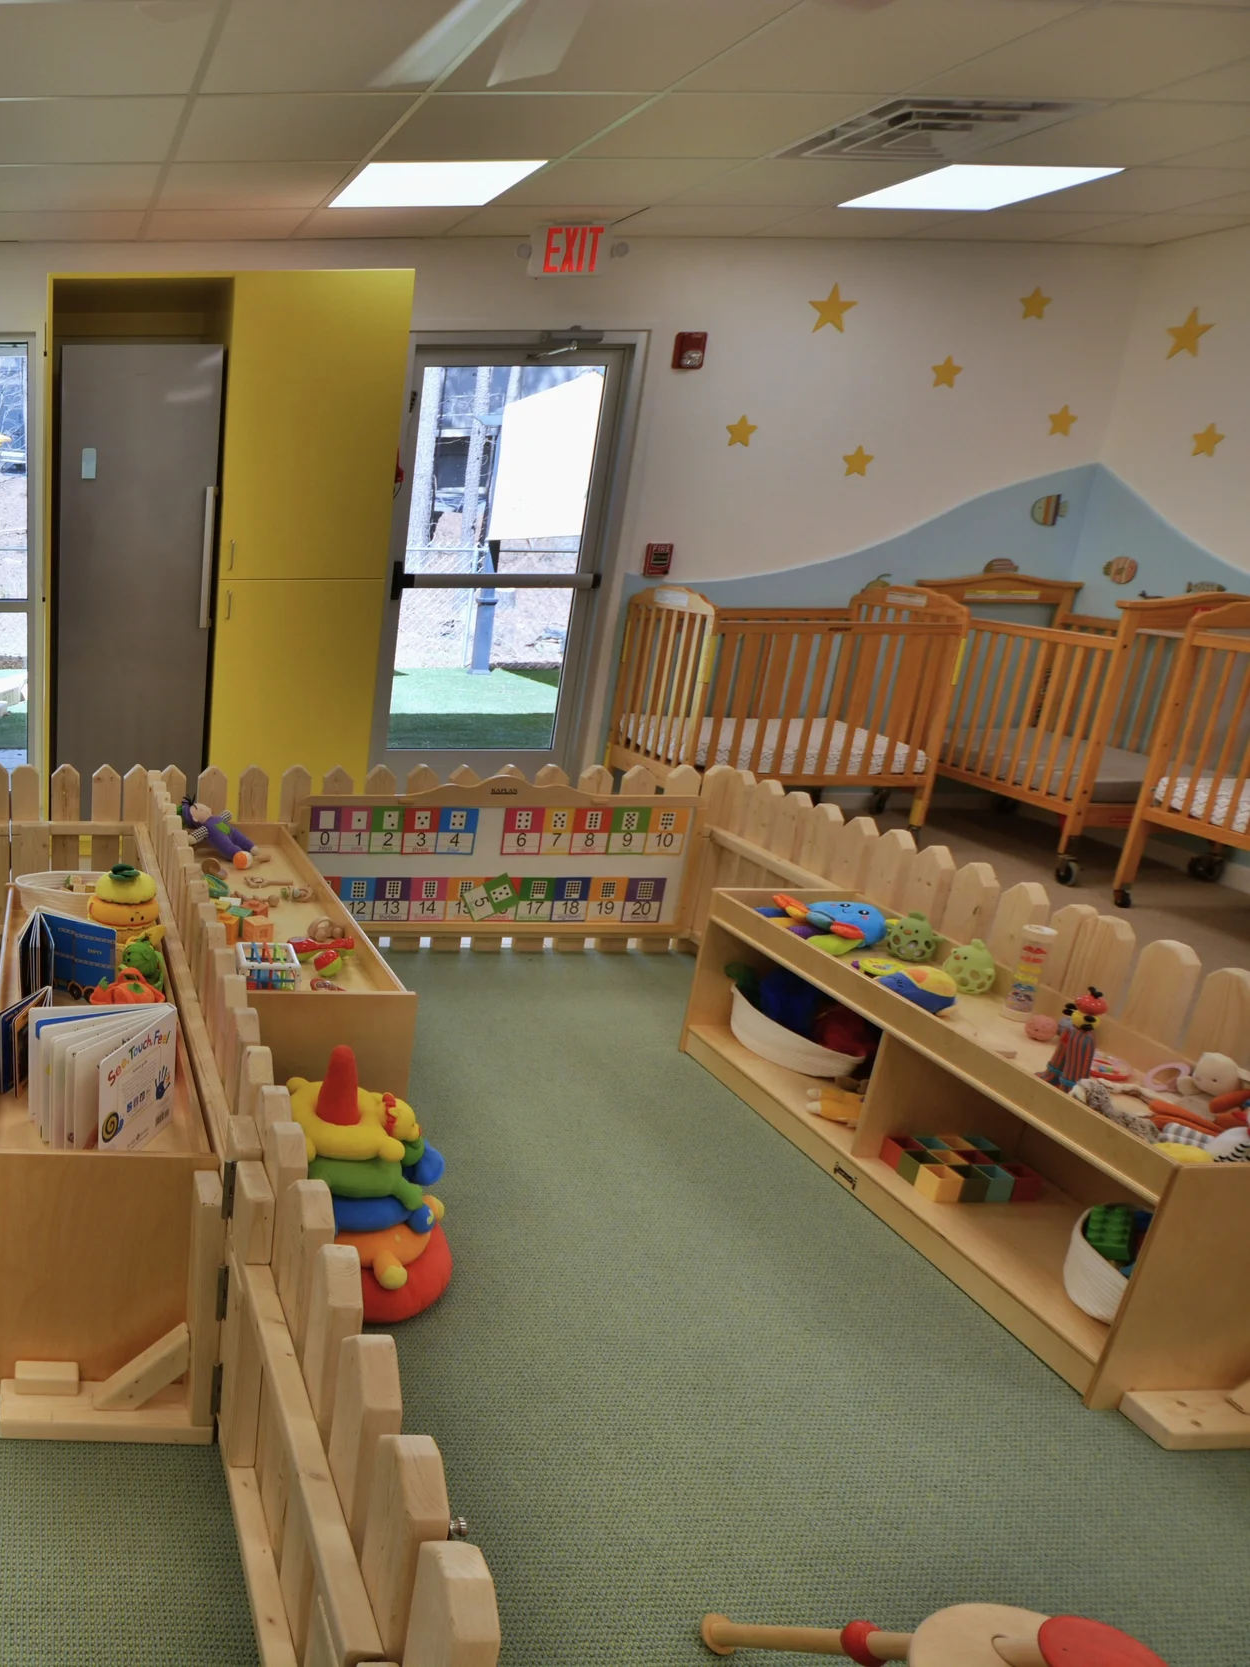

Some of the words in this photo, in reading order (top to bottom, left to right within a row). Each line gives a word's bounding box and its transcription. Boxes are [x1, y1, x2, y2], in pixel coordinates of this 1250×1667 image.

[542, 226, 604, 273] EXIT
[653, 544, 670, 552] FIRE
[320, 831, 330, 845] 0
[355, 833, 362, 846] 1
[383, 832, 393, 846] 2
[416, 832, 426, 846] 3
[450, 833, 460, 846] 4
[516, 833, 526, 846] 6
[552, 833, 562, 846] 7
[584, 833, 594, 846] 8
[622, 833, 632, 847] 9
[656, 833, 673, 847] 10
[348, 901, 366, 914] 12
[382, 901, 400, 914] 13
[419, 901, 436, 914] 14
[526, 901, 543, 914] 17
[562, 901, 579, 914] 18
[597, 901, 614, 915] 19
[632, 902, 650, 915] 20
[474, 896, 489, 907] 5
[153, 1030, 170, 1045] Feel
